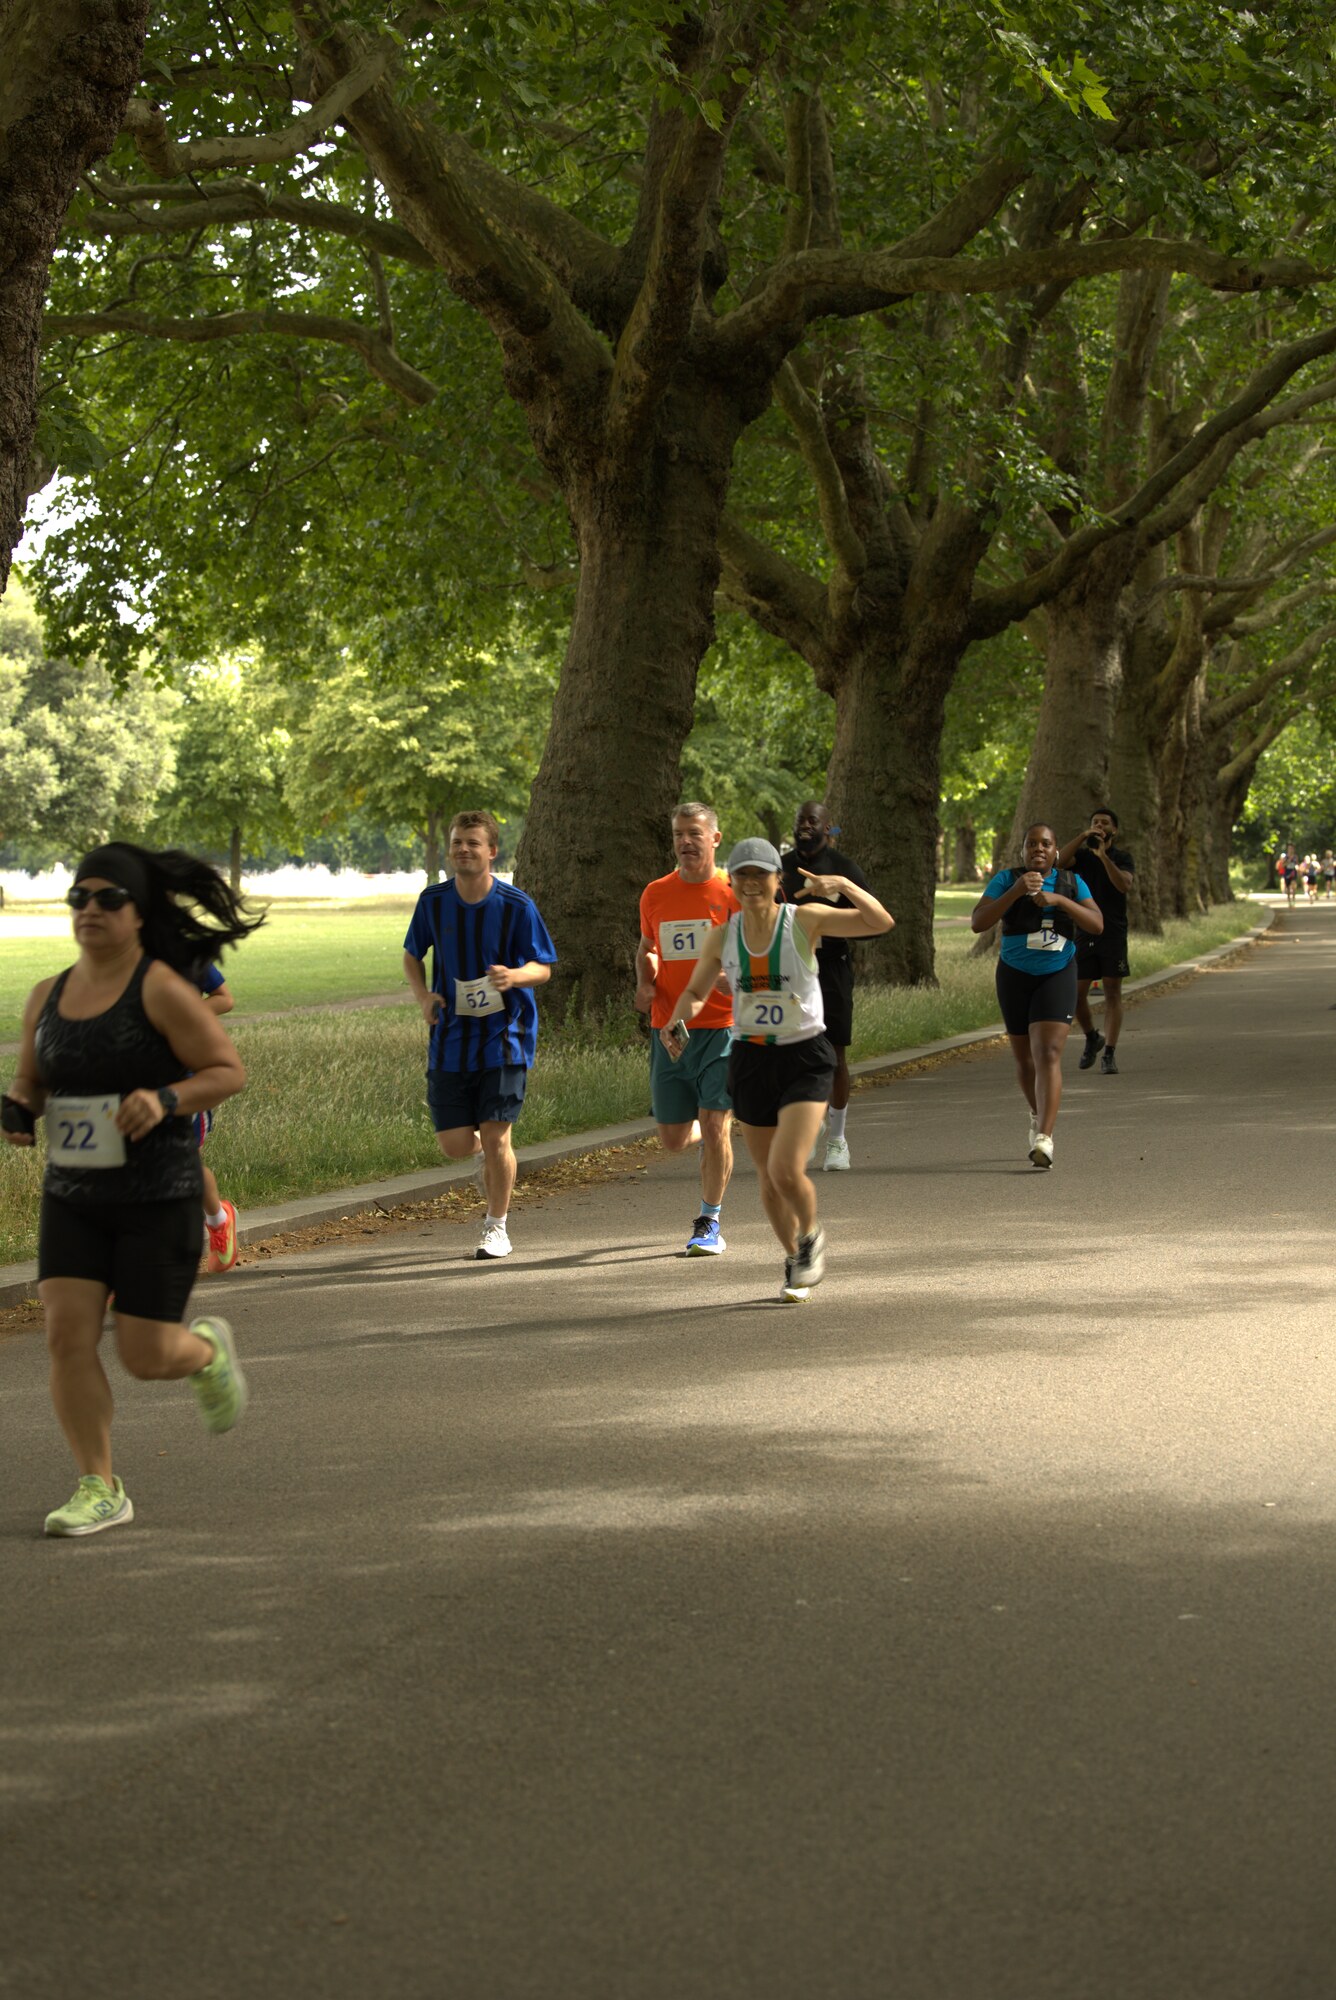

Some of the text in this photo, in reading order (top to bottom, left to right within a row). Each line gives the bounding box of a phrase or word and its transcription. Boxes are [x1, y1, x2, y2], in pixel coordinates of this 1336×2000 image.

[673, 932, 695, 951] 61
[755, 1004, 784, 1025] 20
[59, 1120, 98, 1150] 22
